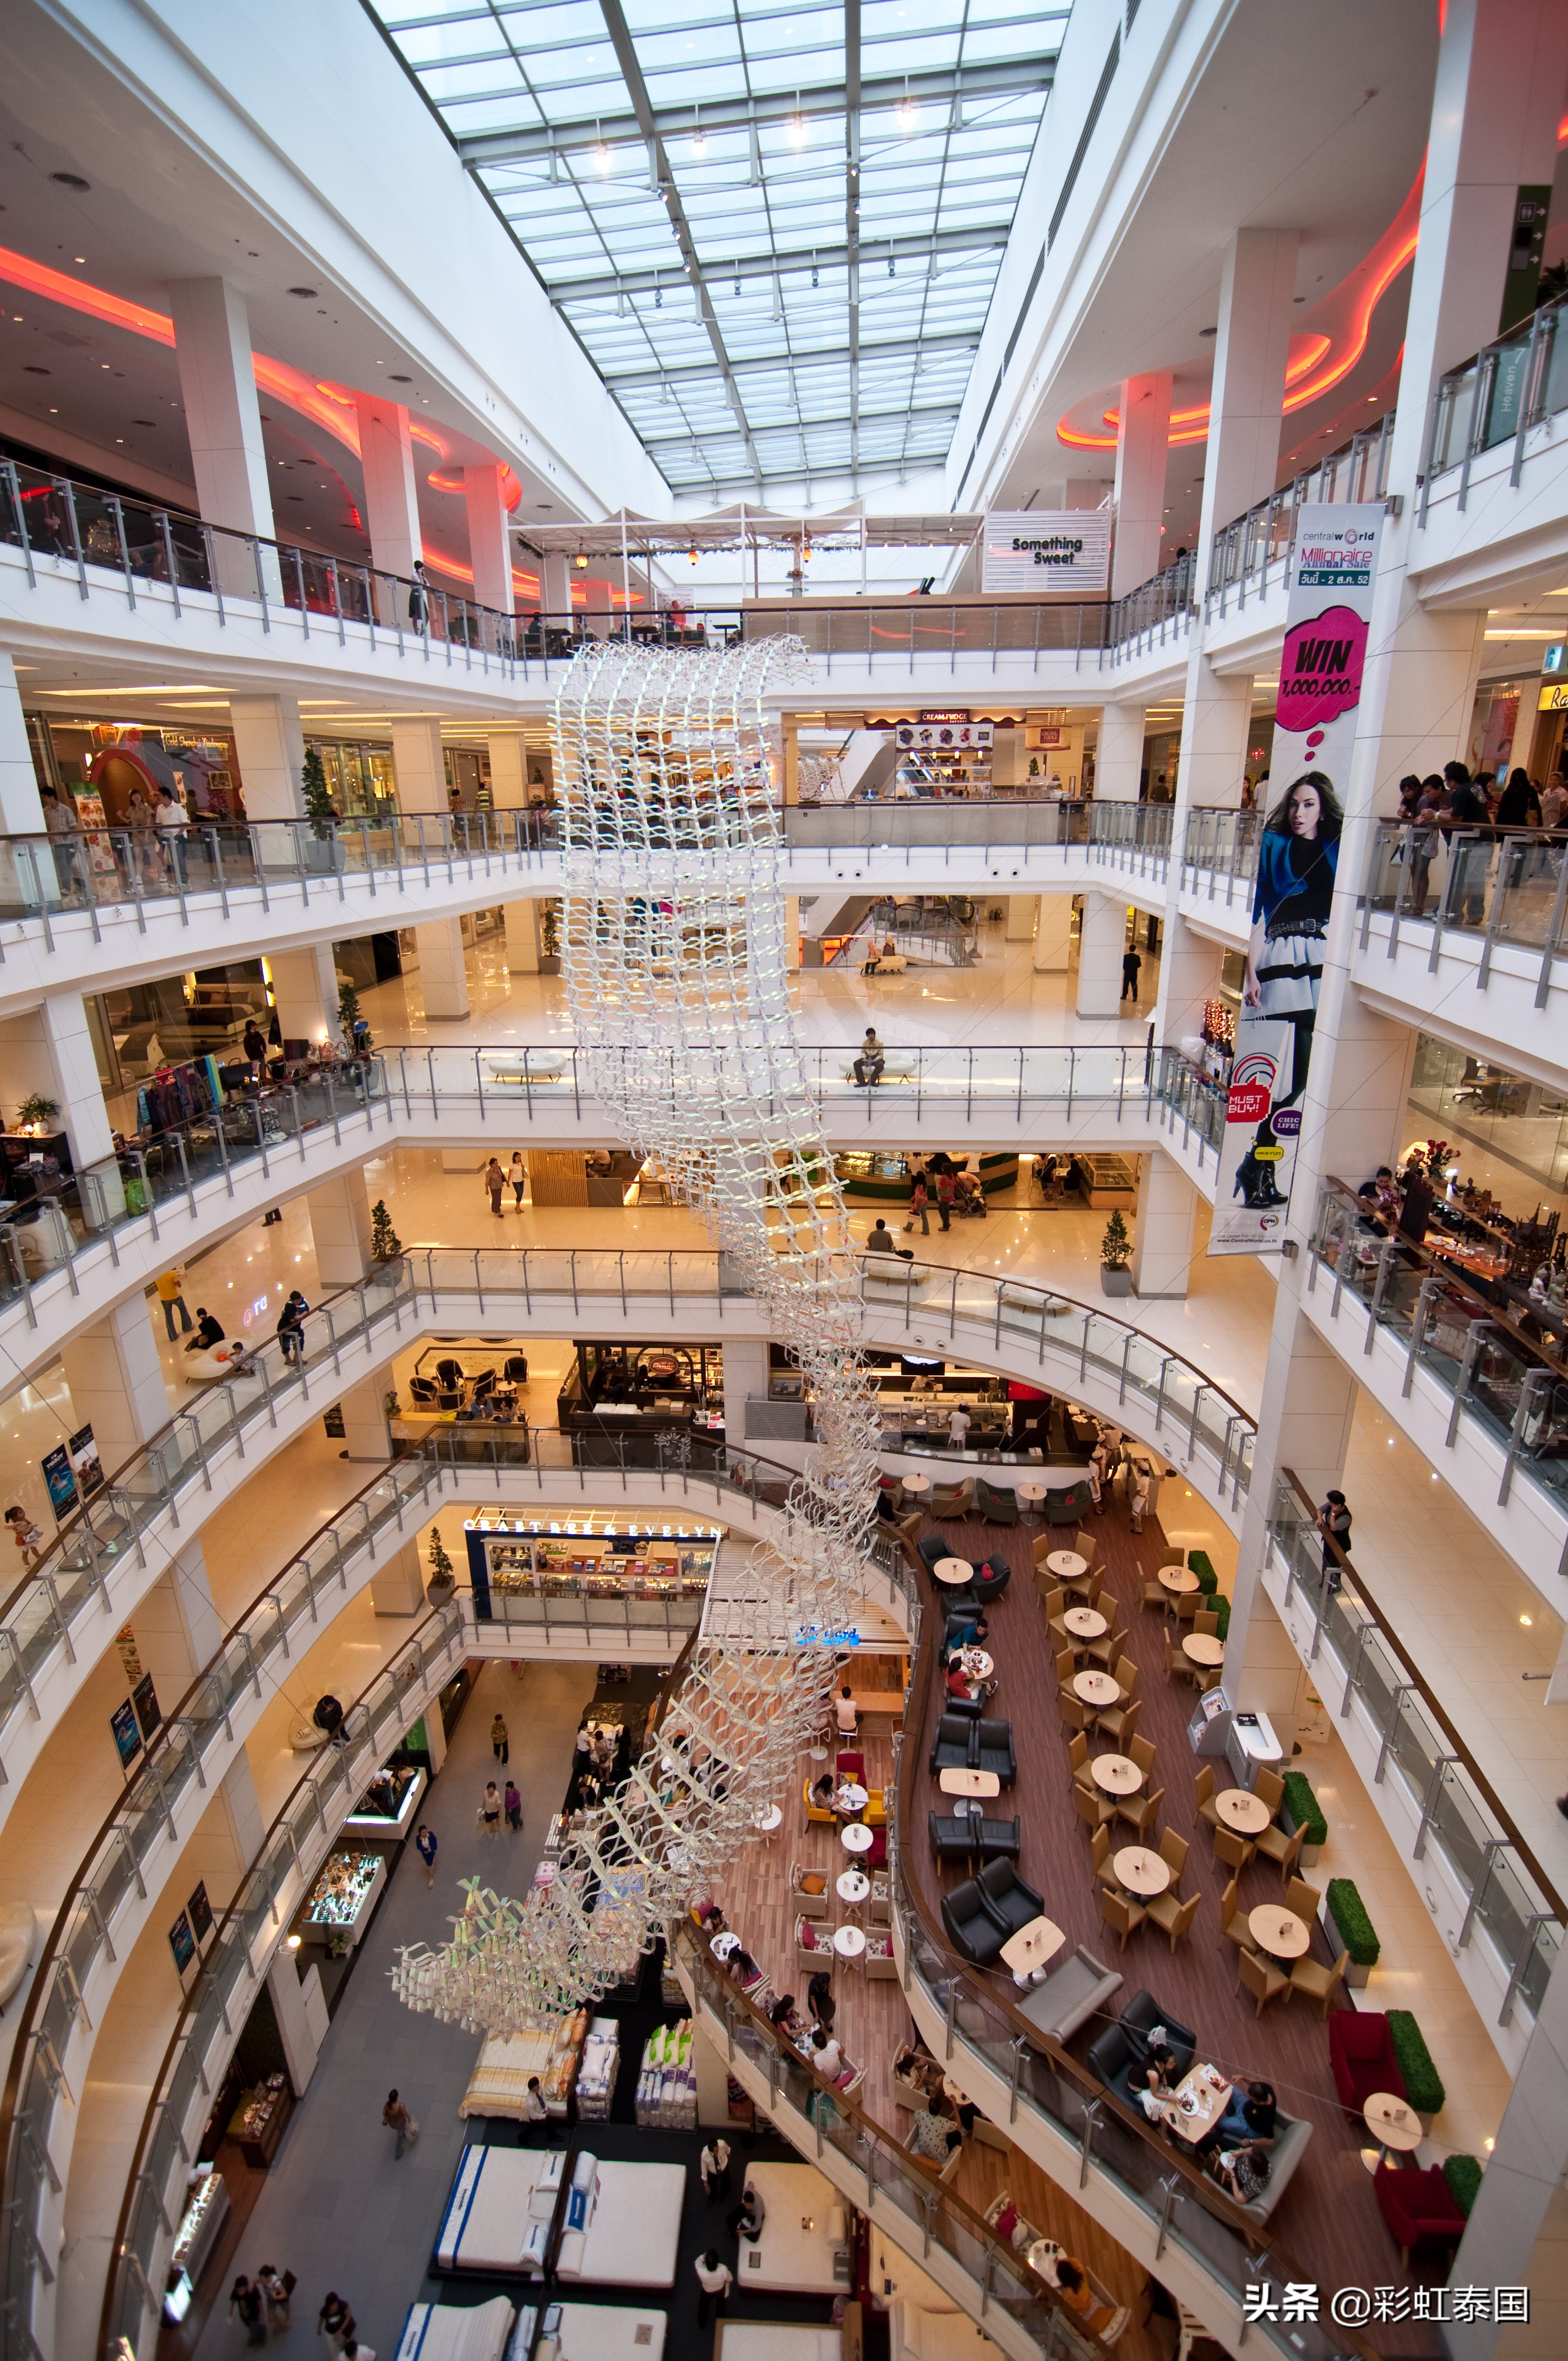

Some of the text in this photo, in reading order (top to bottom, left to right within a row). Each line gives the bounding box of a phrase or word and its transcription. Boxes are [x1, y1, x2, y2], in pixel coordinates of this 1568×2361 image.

[1501, 347, 1526, 412] Heaven 7
[1012, 536, 1083, 552] Something
[1034, 552, 1075, 564] Sweet
[1300, 547, 1373, 562] Millionaire
[1302, 559, 1369, 569] Annual Sale
[1301, 572, 1320, 584] วันนี้
[1327, 575, 1334, 584] 2
[1337, 576, 1354, 584] ส.ค.
[1357, 575, 1368, 584] 52
[1294, 637, 1354, 676] WIN
[165, 735, 178, 746] Gold
[179, 736, 201, 749] Shanghai
[1229, 1095, 1263, 1105] MUST
[1228, 1103, 1259, 1113] BUY!
[46, 1452, 64, 1470] TISSOT
[463, 1519, 722, 1537] CRABTREE & EVELYN
